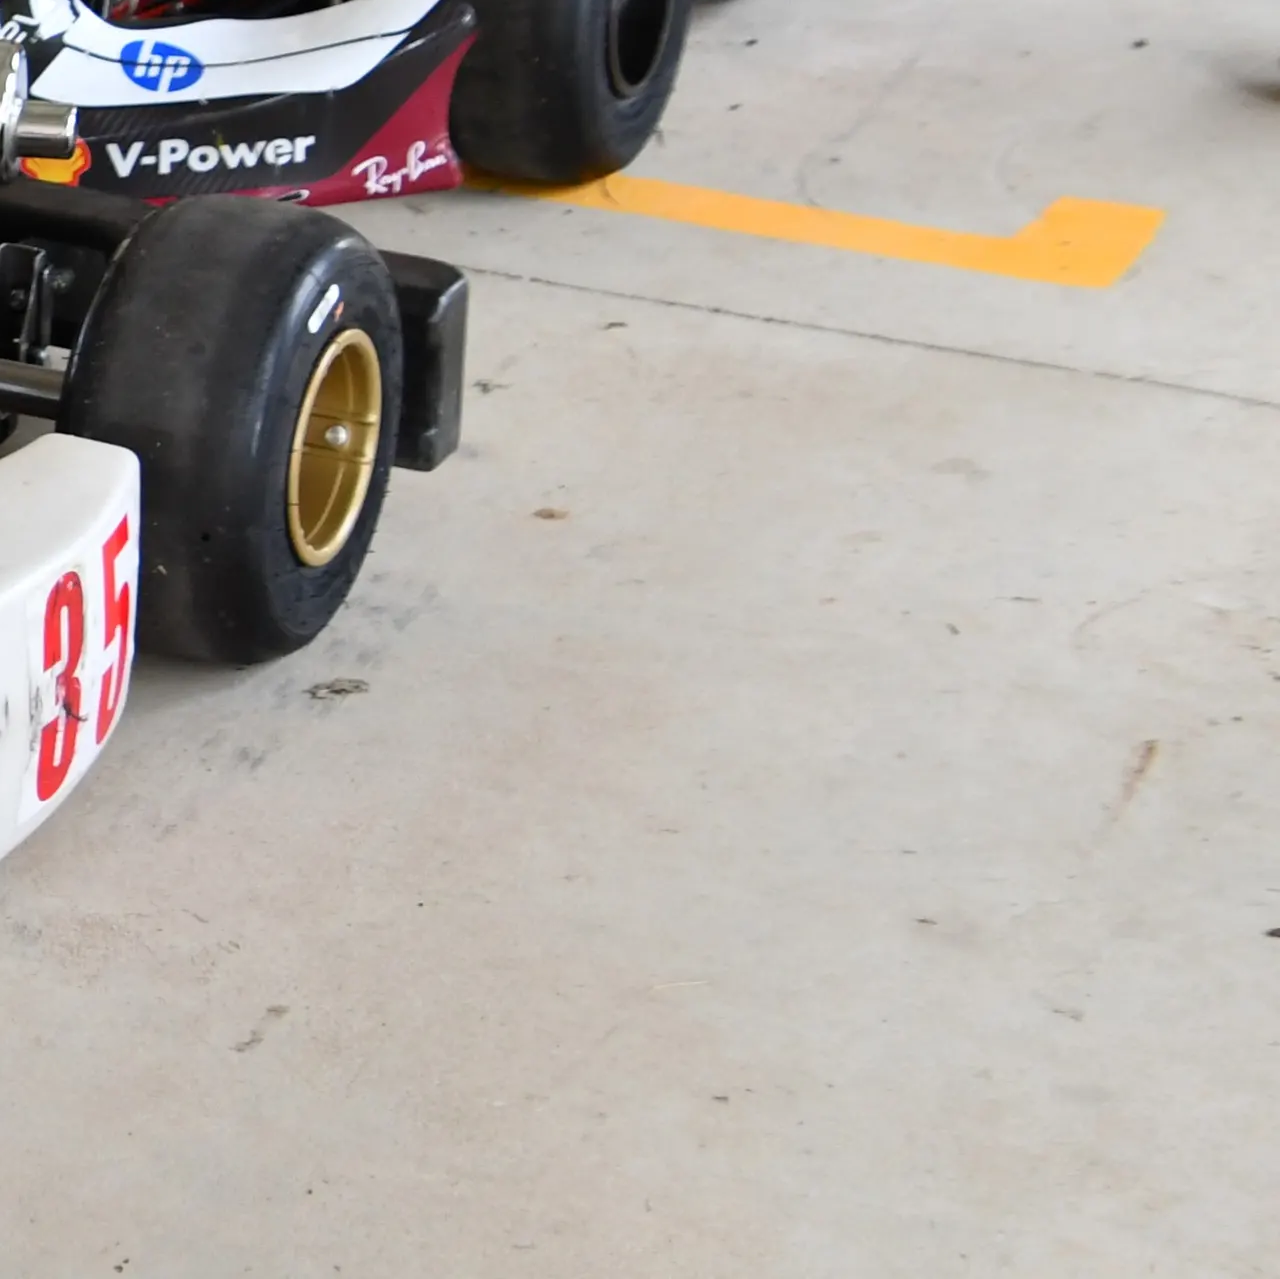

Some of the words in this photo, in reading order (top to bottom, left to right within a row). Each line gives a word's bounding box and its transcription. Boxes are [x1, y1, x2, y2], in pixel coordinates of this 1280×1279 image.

[106, 134, 317, 181] V-Power
[351, 139, 448, 196] Ray-Ban
[36, 512, 130, 802] 35
